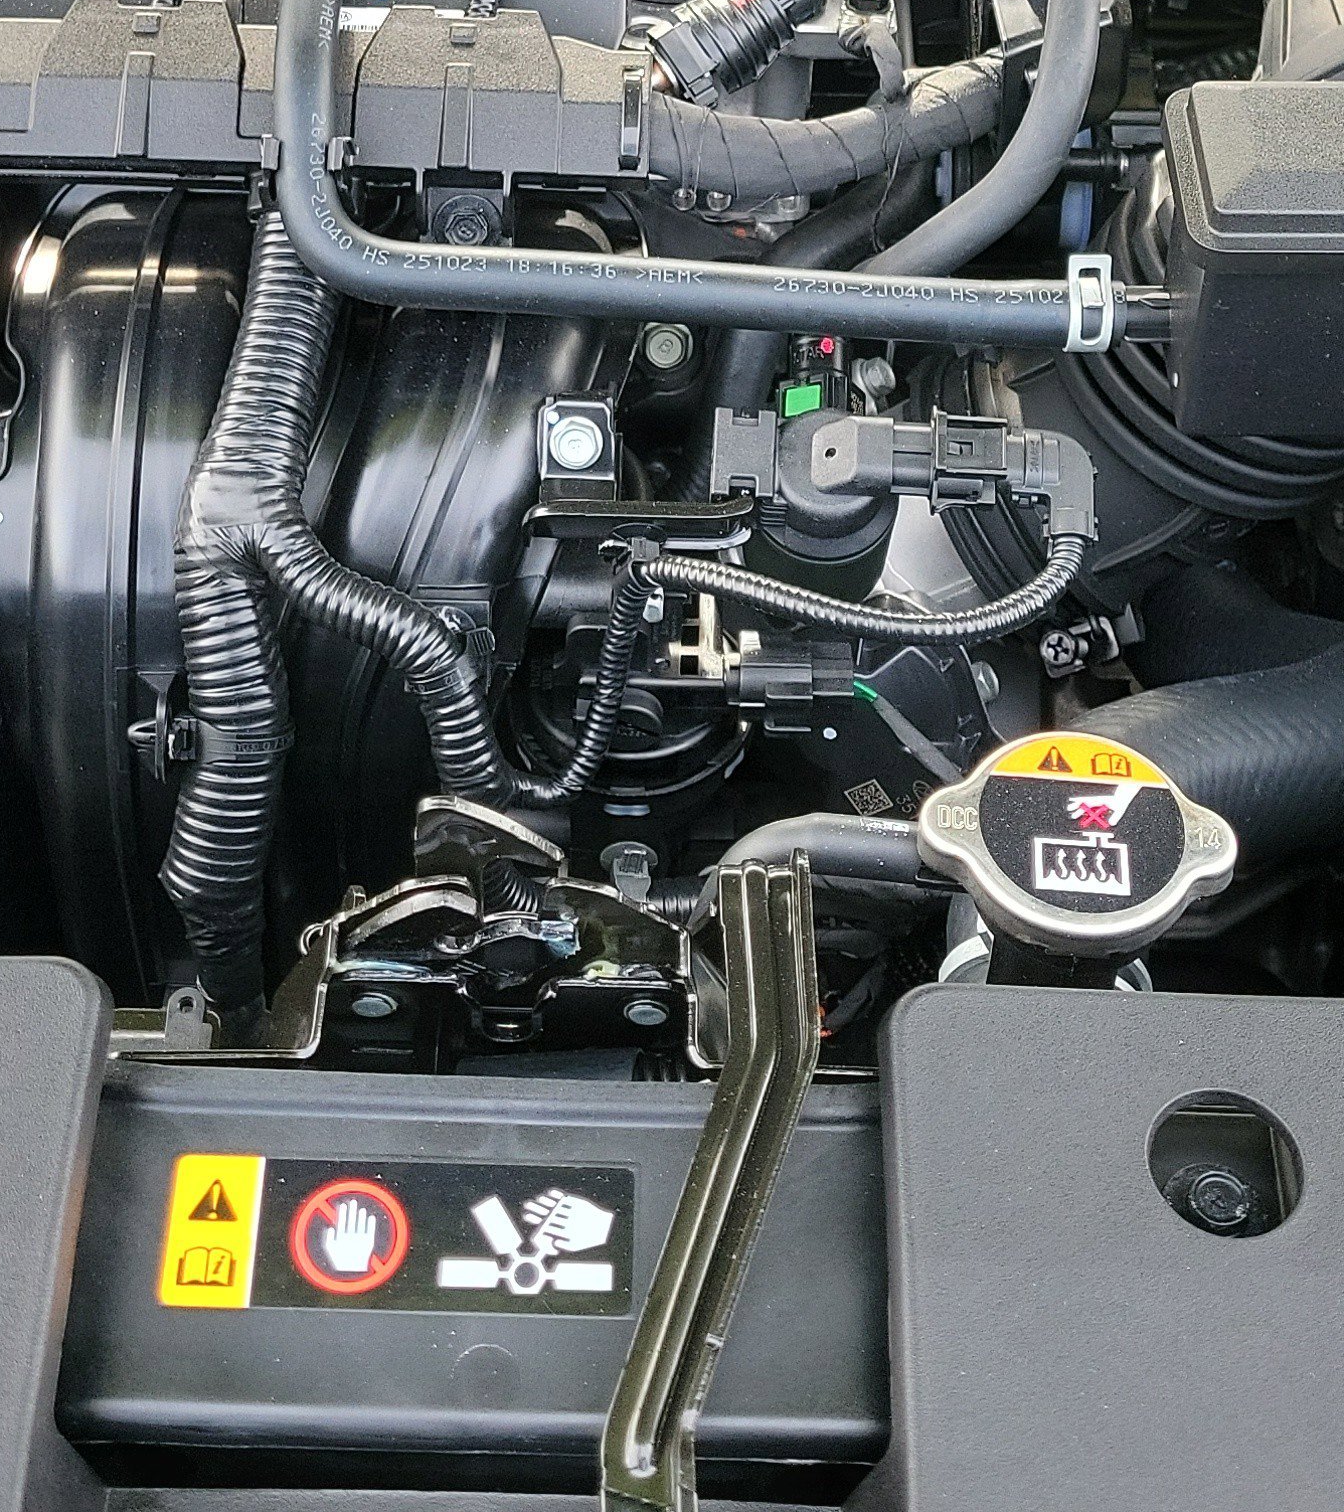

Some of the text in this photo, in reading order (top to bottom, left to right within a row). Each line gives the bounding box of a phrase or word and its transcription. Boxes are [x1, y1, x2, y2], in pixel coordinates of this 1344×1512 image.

[309, 112, 354, 251] 26730-2J040
[362, 245, 390, 266] HS
[403, 253, 488, 272] 251023
[773, 275, 936, 301] 26730-2J040
[950, 290, 979, 303] HS
[994, 289, 1066, 305] 25102
[937, 804, 979, 830] DCC
